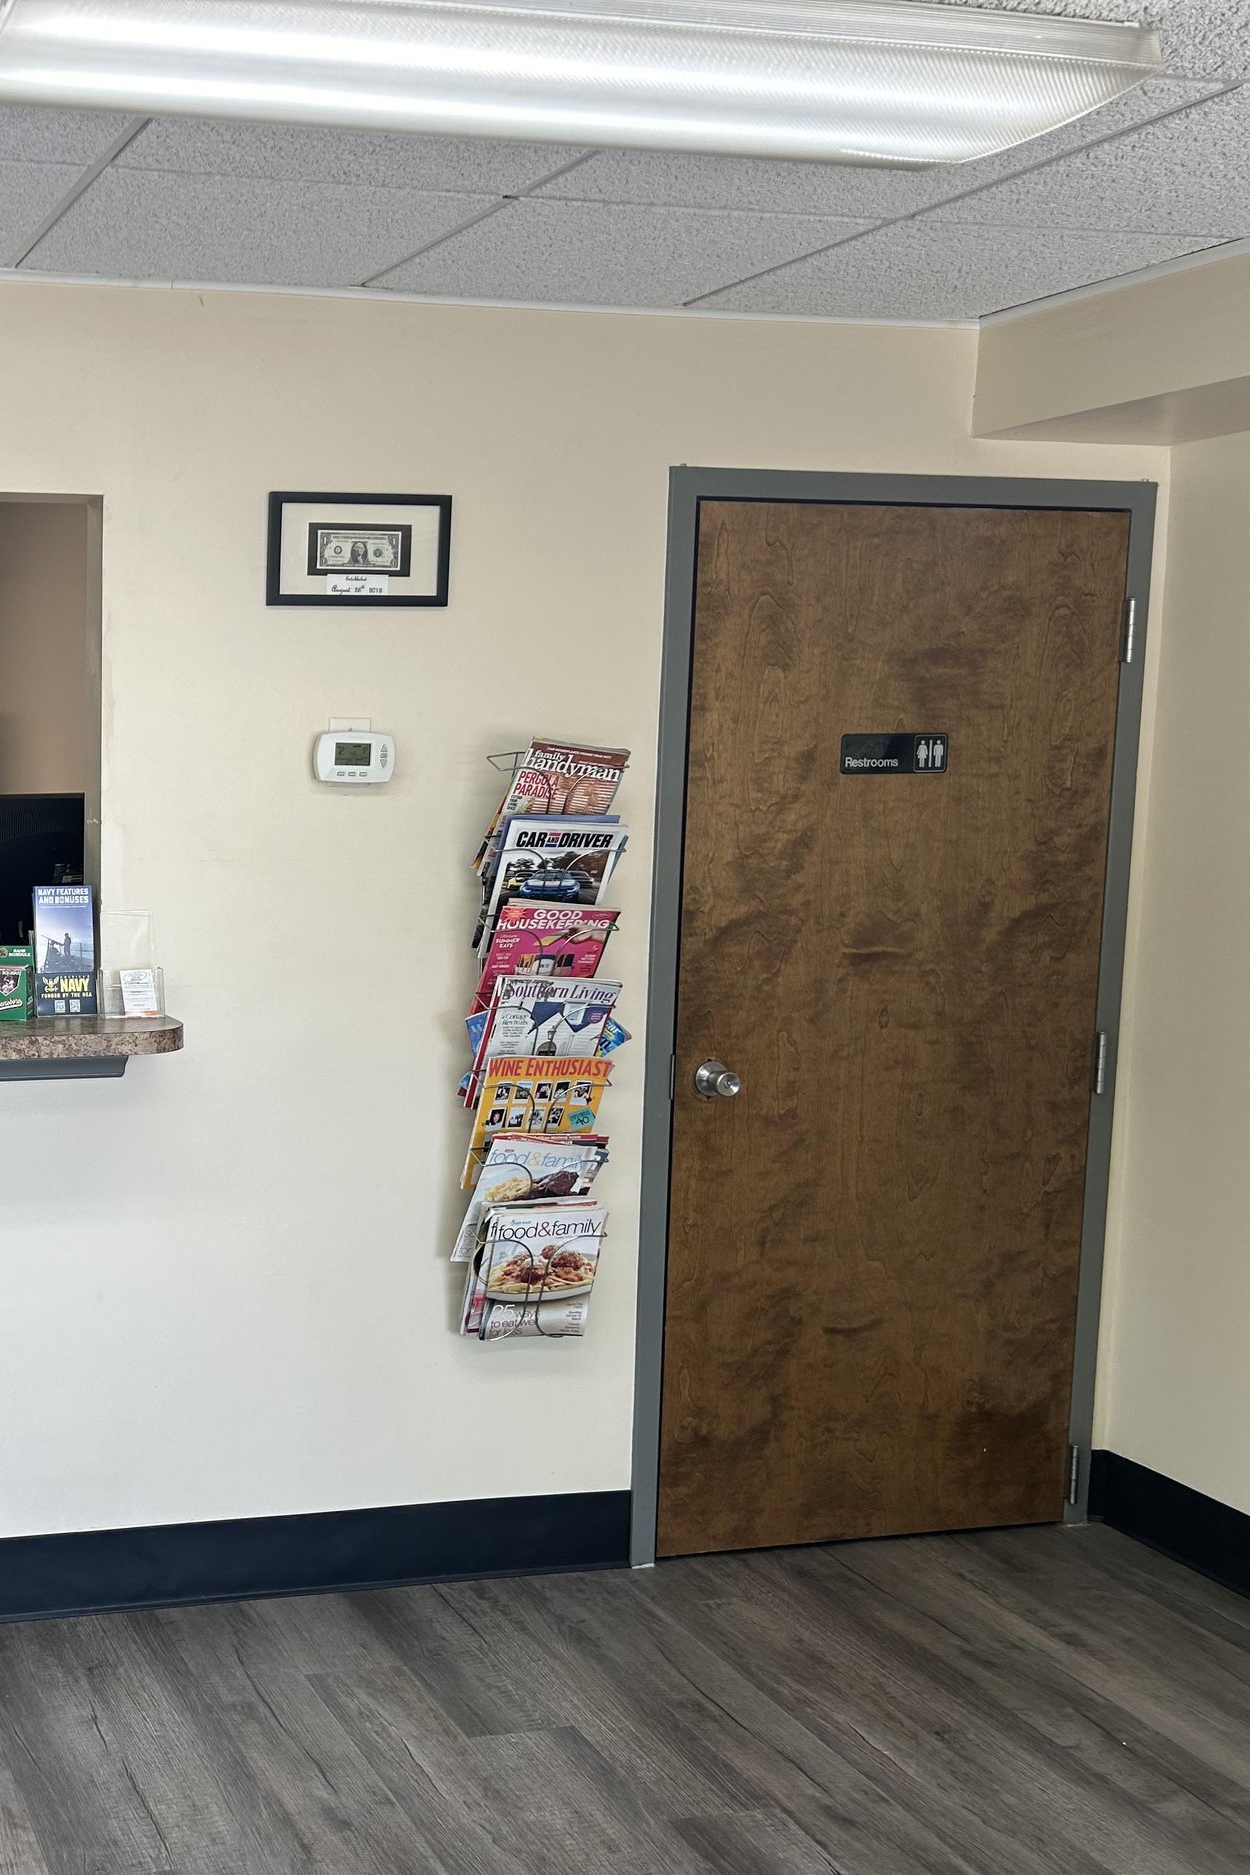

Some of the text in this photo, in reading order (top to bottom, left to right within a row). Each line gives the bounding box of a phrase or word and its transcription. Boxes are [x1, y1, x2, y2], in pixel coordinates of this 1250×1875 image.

[534, 750, 566, 761] family
[845, 757, 898, 767] Restrooms
[521, 748, 621, 781] handyman
[513, 783, 559, 799] PARADISE
[516, 831, 548, 847] CAR
[558, 833, 614, 848] DRIVER
[534, 909, 583, 920] GOOD
[60, 978, 89, 992] NAVY
[570, 985, 614, 1003] Living
[490, 1059, 613, 1077] WINE ENTHUSIAST
[492, 1304, 515, 1318] 25
[490, 1319, 501, 1327] to
